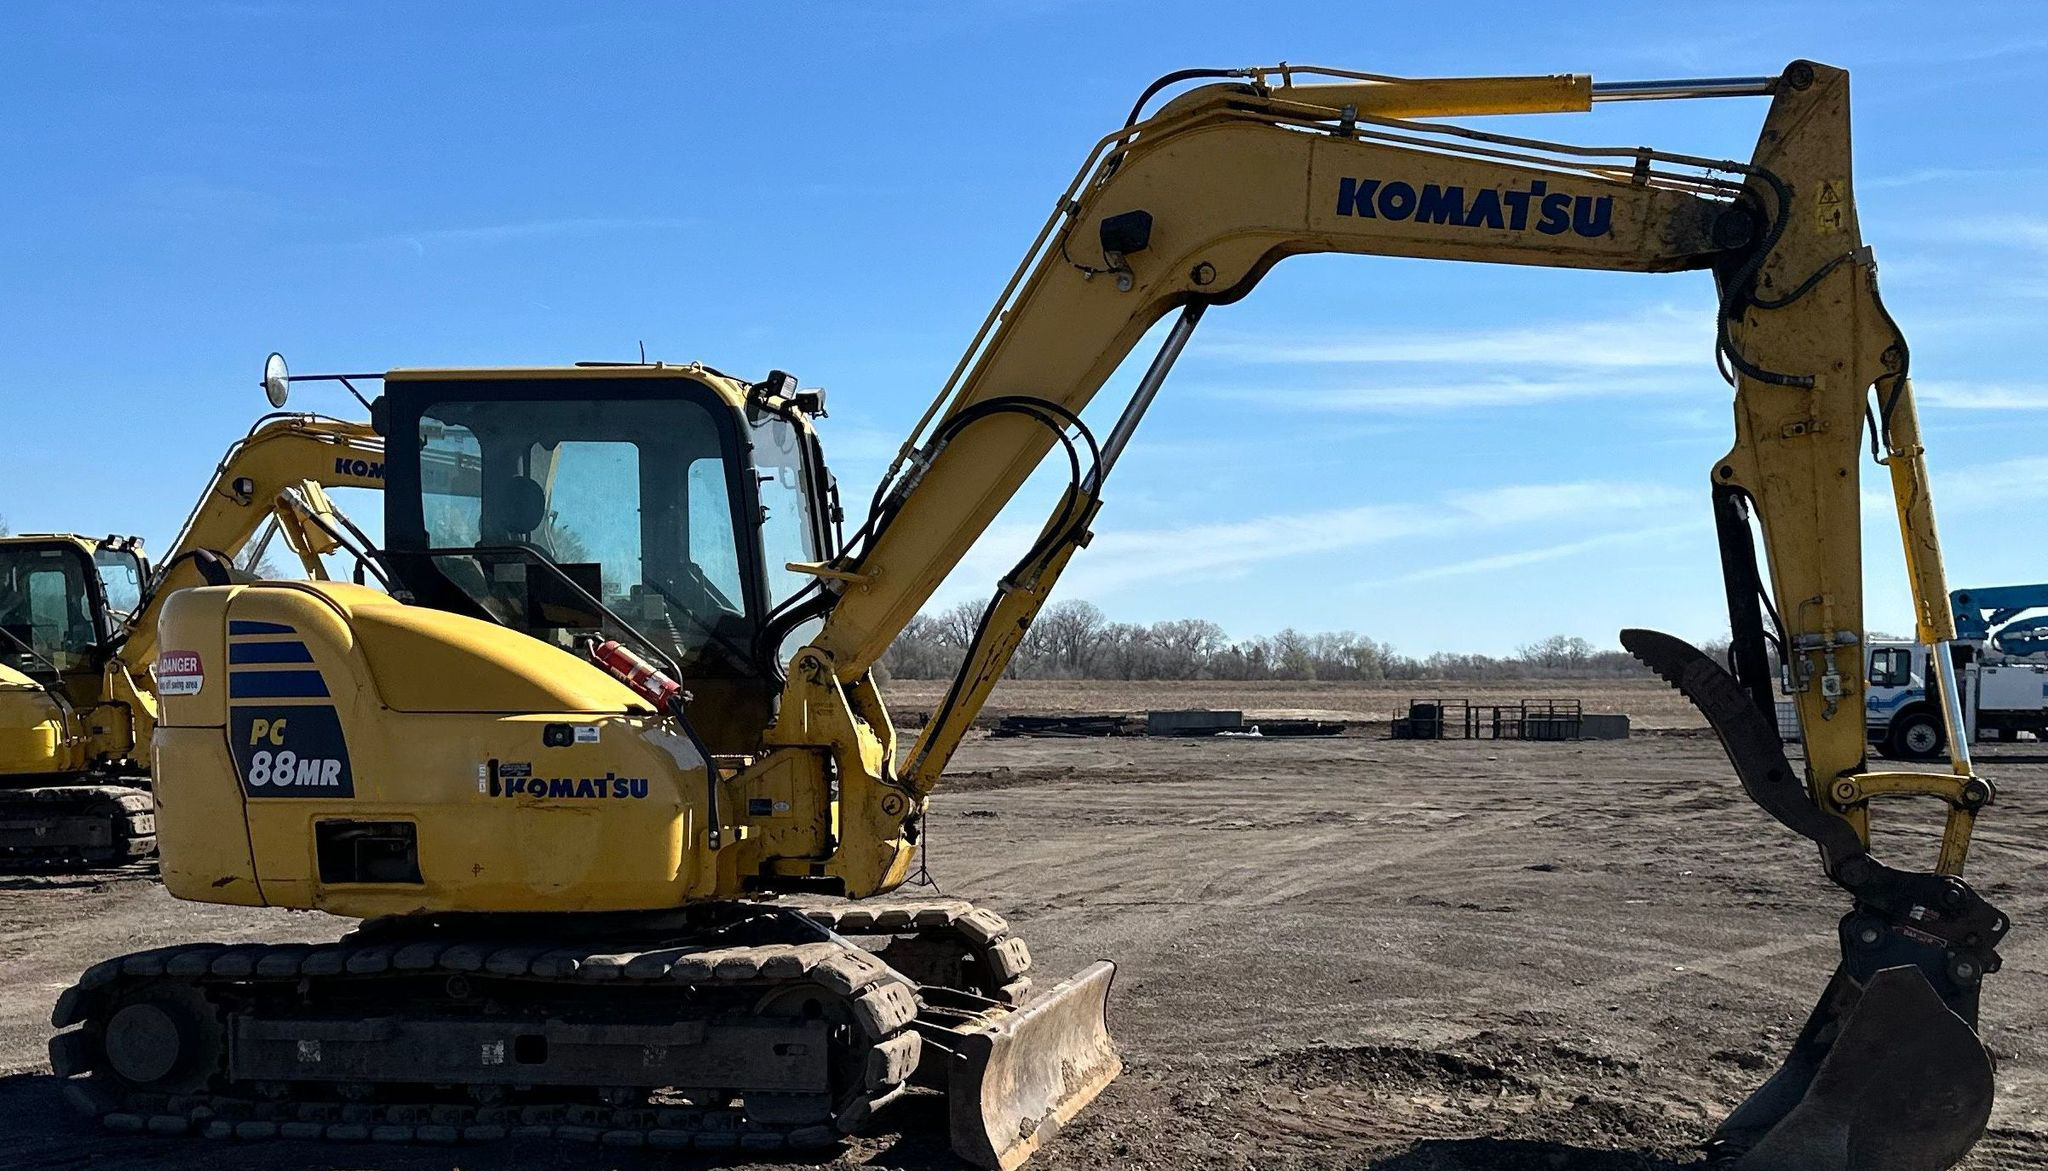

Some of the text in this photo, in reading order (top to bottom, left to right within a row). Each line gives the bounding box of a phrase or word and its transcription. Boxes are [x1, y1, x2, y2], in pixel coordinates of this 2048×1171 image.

[1336, 177, 1613, 237] KOMATSU
[163, 657, 198, 672] DANGER
[185, 680, 198, 689] area
[249, 718, 287, 746] PC
[248, 750, 341, 787] 88MR
[505, 772, 648, 799] KOMATSU
